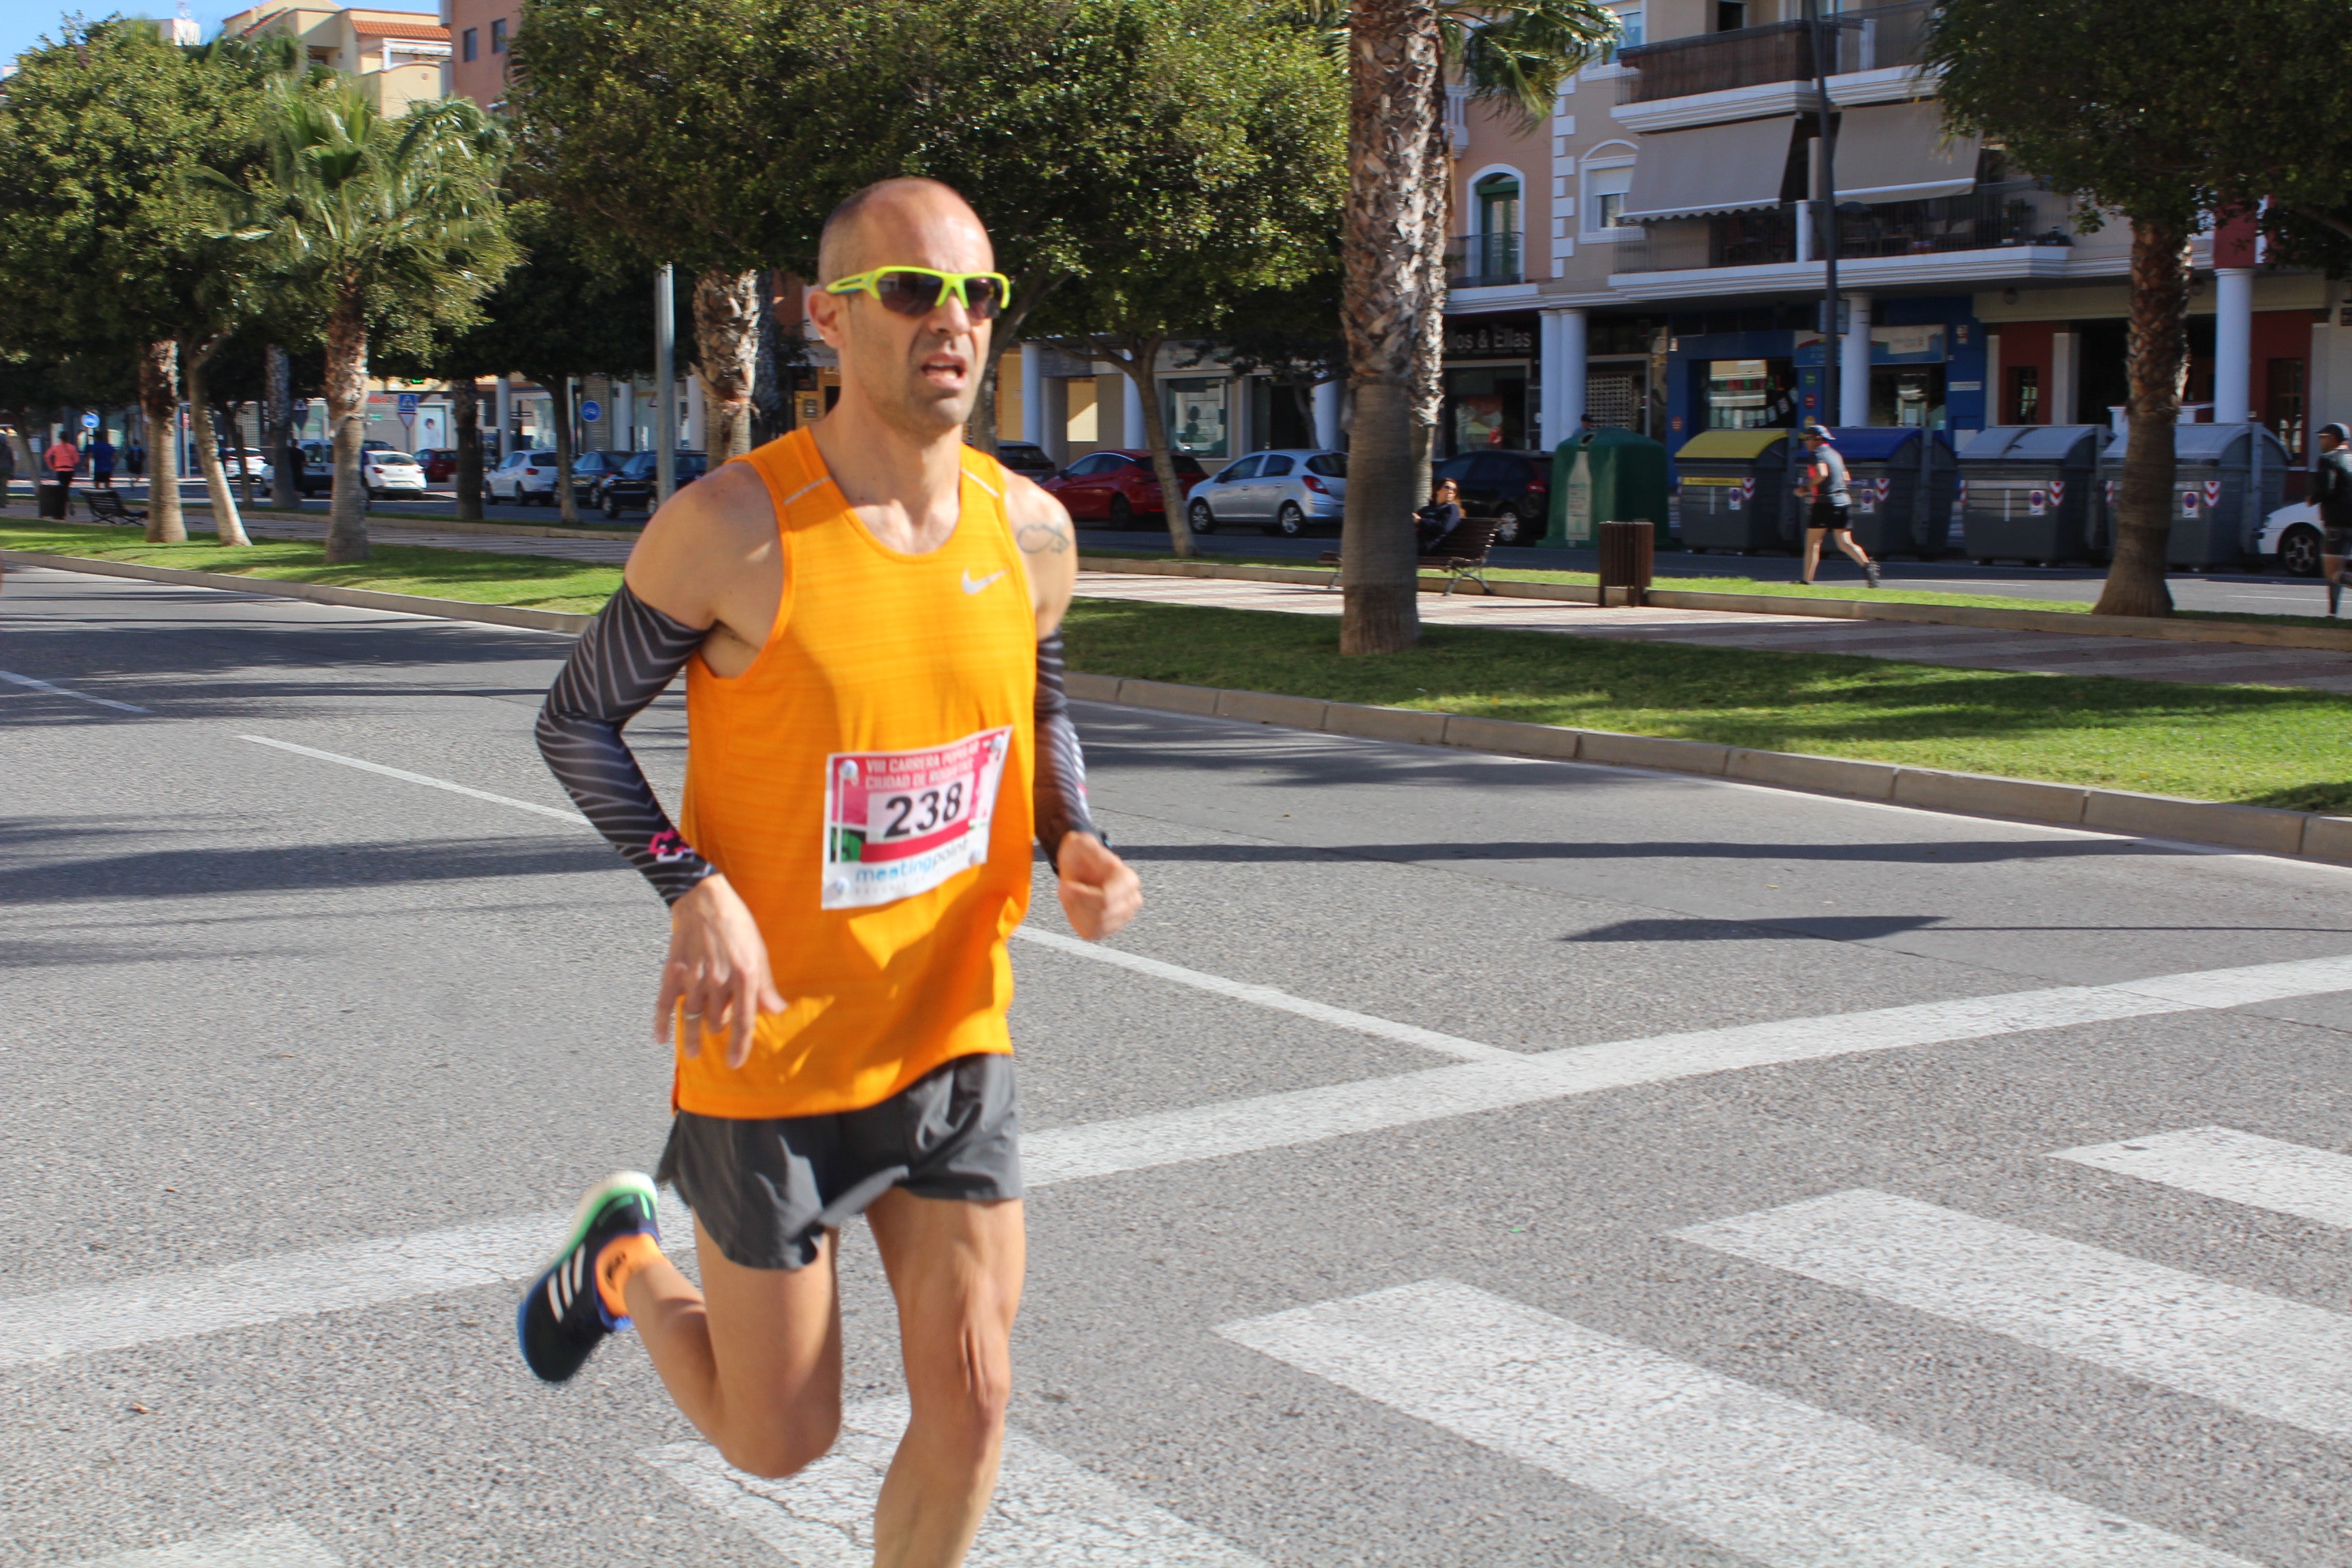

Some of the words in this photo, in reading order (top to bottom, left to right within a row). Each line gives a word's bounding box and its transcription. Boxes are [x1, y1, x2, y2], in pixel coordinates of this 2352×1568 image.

[1447, 330, 1474, 349] llos
[1477, 329, 1488, 348] &
[1493, 328, 1531, 348] Ellas
[889, 753, 941, 773] CARRERA
[865, 773, 911, 791] CIUDAD
[913, 771, 927, 787] DE
[883, 781, 962, 838] 238
